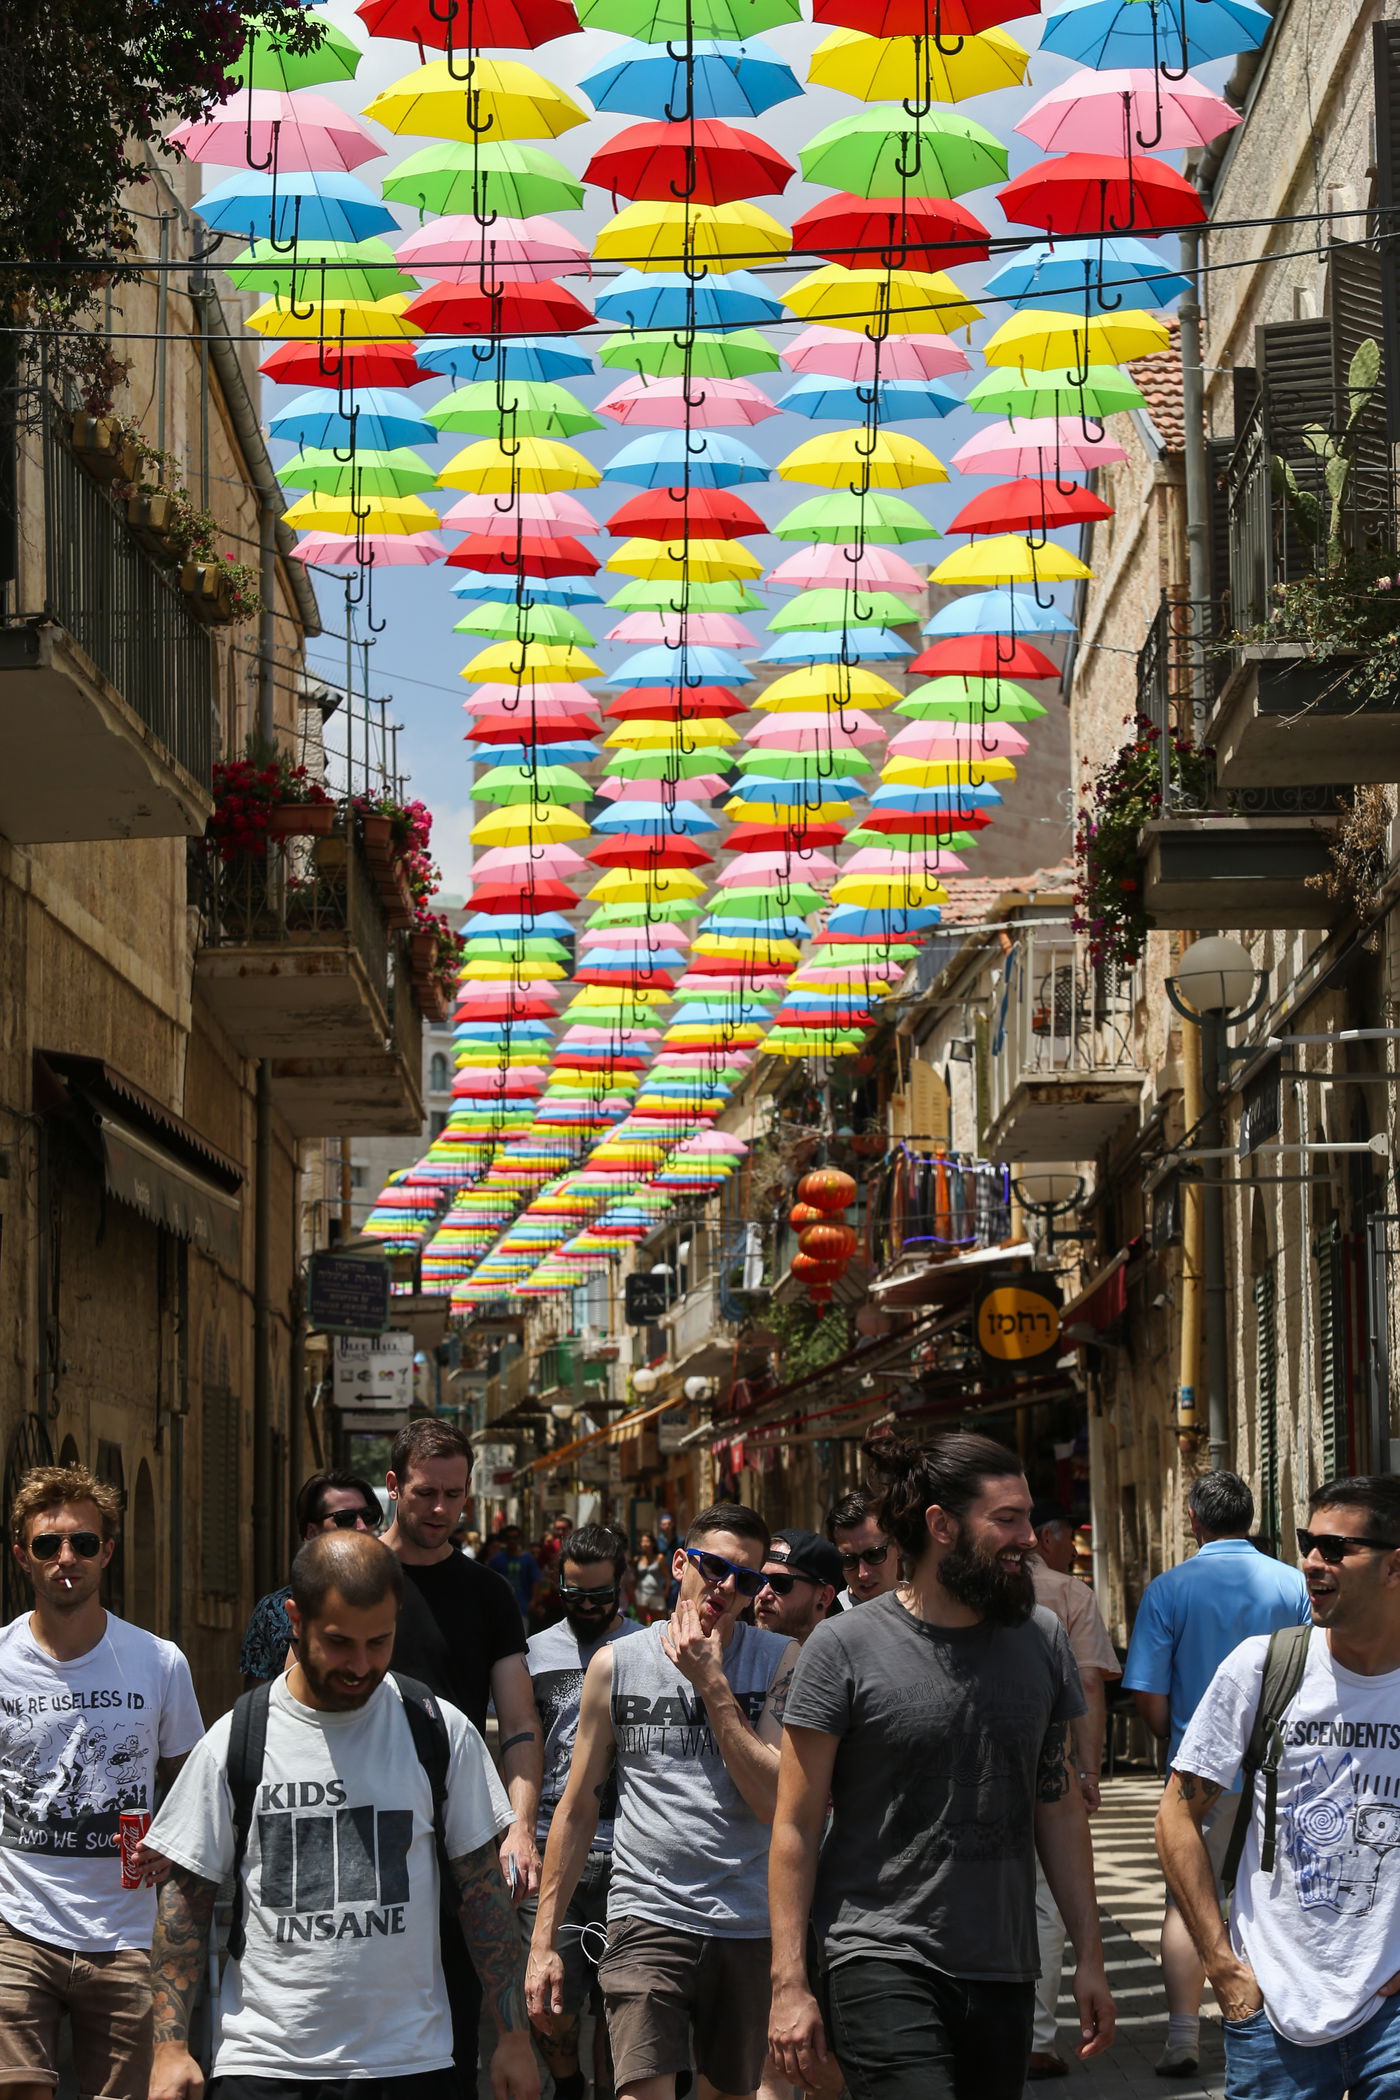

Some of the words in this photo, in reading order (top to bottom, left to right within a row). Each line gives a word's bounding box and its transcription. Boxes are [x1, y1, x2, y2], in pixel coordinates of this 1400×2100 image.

[1, 1694, 48, 1717] WE'RE
[51, 1690, 123, 1712] USELESS
[261, 1779, 347, 1811] KIDS
[53, 1830, 78, 1849] WE
[85, 1831, 121, 1850] SUC
[276, 1906, 407, 1943] INSANE
